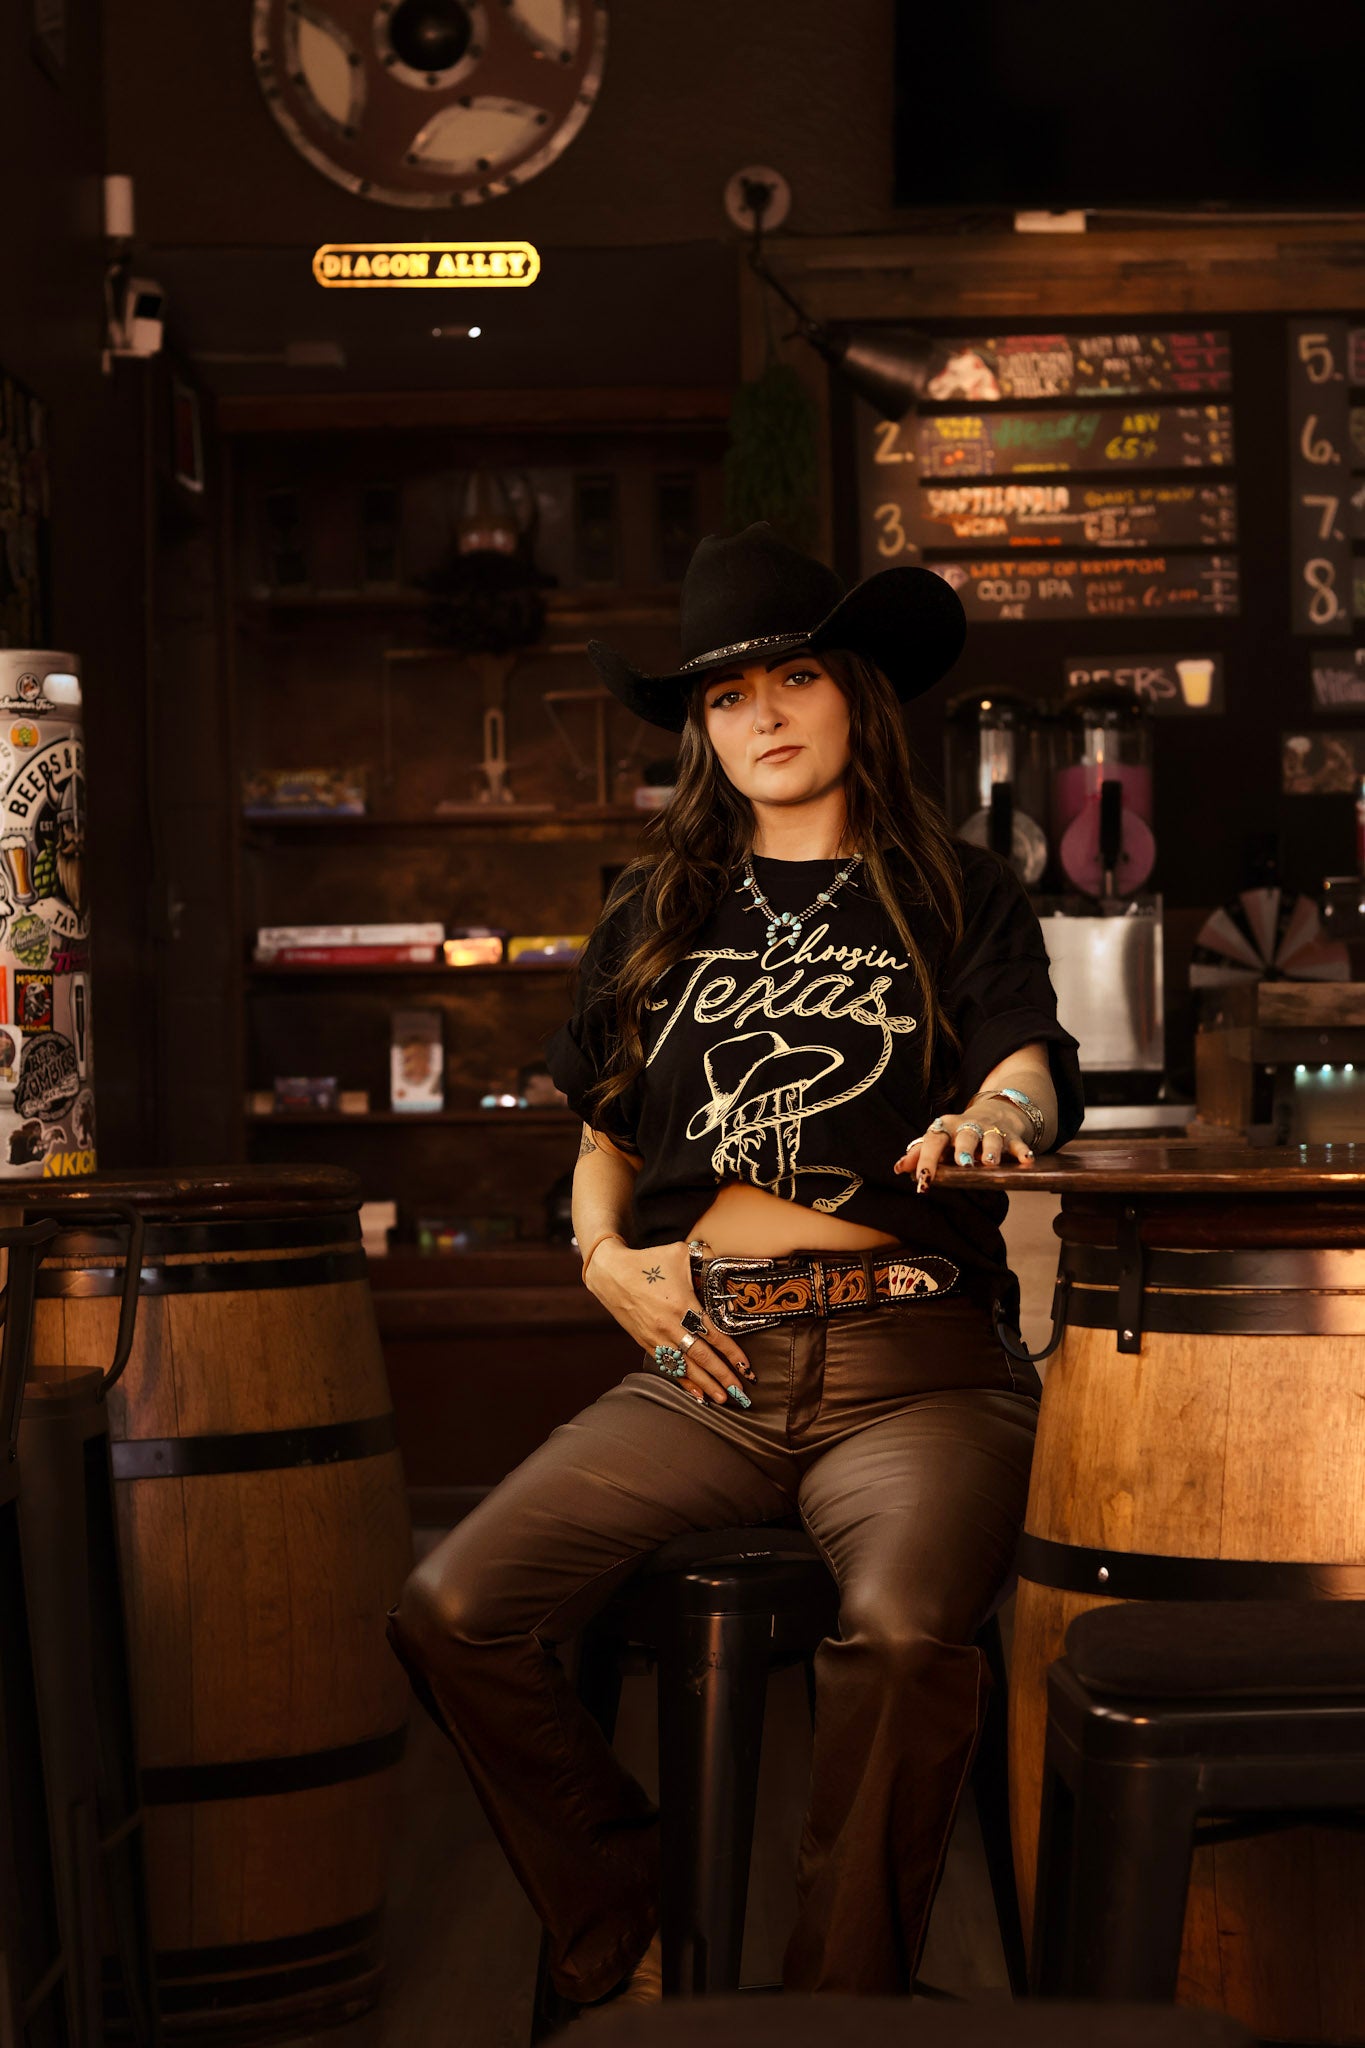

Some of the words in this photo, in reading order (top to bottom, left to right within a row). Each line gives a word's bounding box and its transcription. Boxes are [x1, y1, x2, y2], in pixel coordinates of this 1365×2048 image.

[322, 252, 430, 279] DIAGON
[435, 252, 528, 278] ALLEY
[1122, 413, 1161, 434] ABV
[976, 579, 1032, 602] COLD
[1037, 579, 1074, 600] IPA
[9, 753, 62, 818] BEERS
[54, 911, 76, 934] TAP
[645, 947, 917, 1068] Texas
